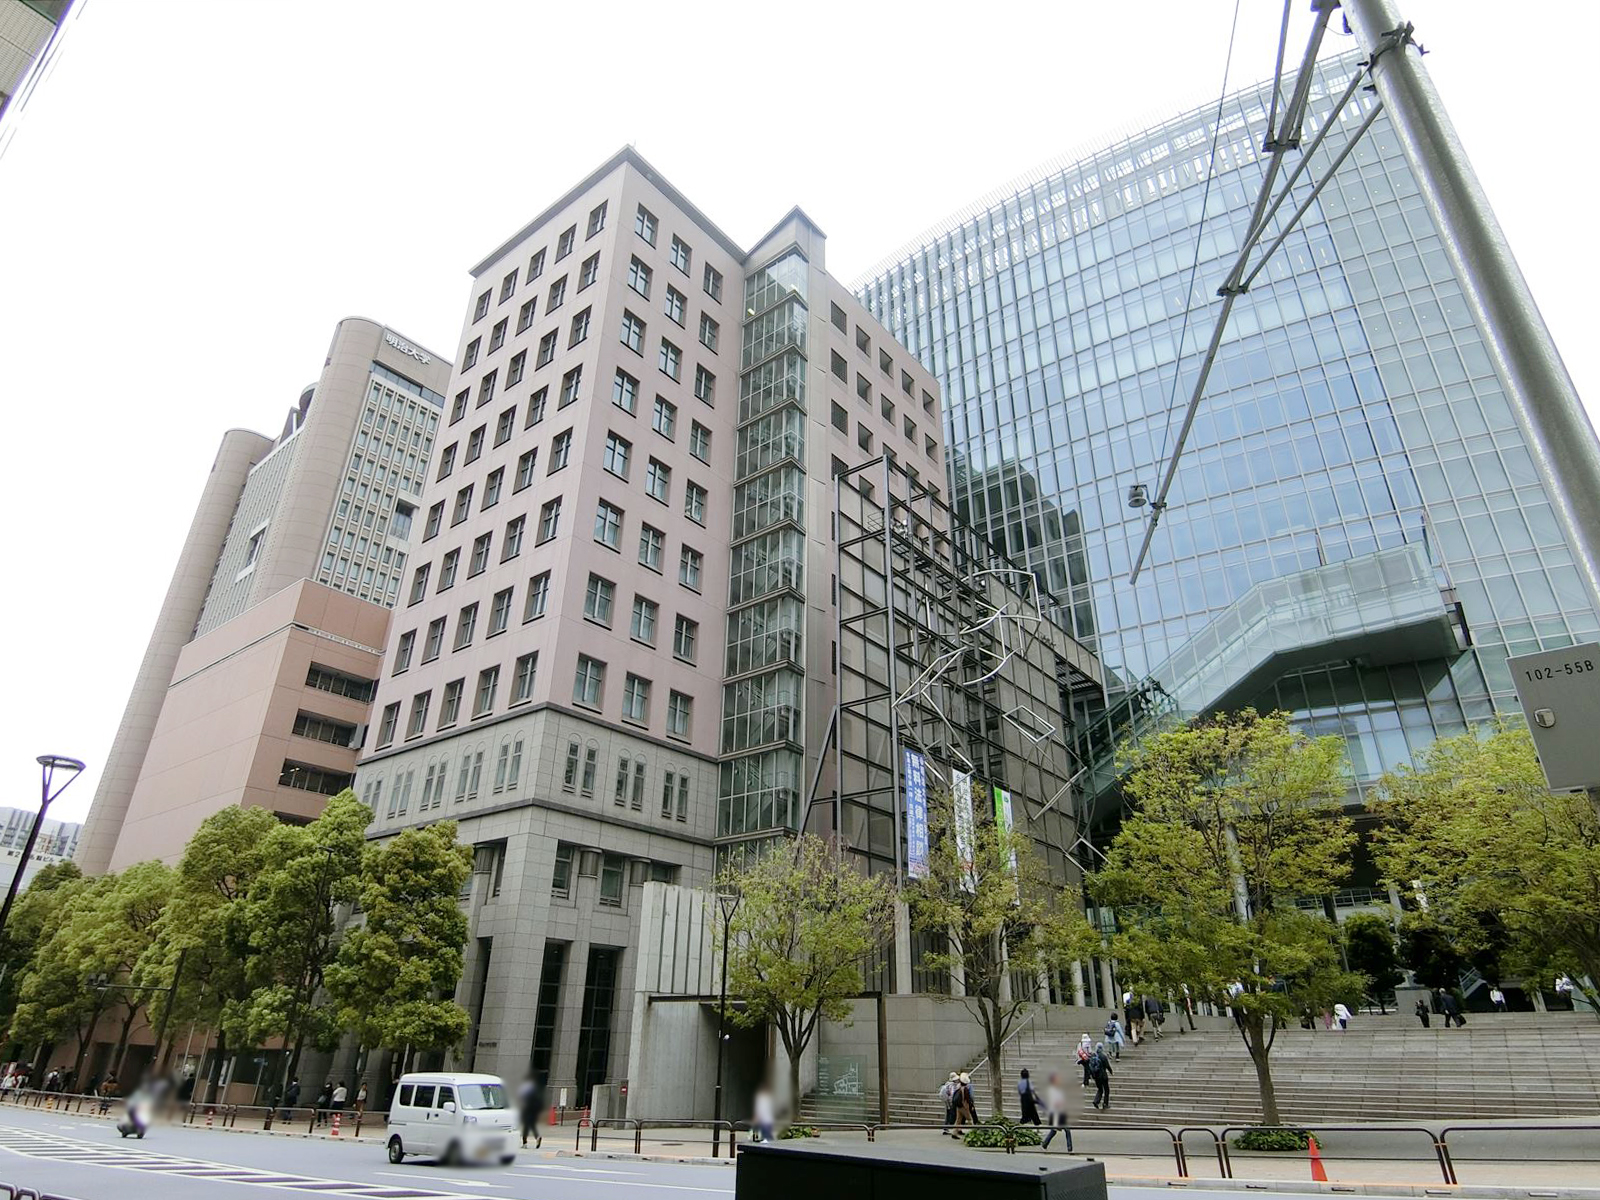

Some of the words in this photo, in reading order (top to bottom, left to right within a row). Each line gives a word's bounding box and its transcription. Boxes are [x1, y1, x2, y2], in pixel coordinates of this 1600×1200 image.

[385, 333, 431, 365] 明治大学
[1526, 660, 1594, 681] 102-55B
